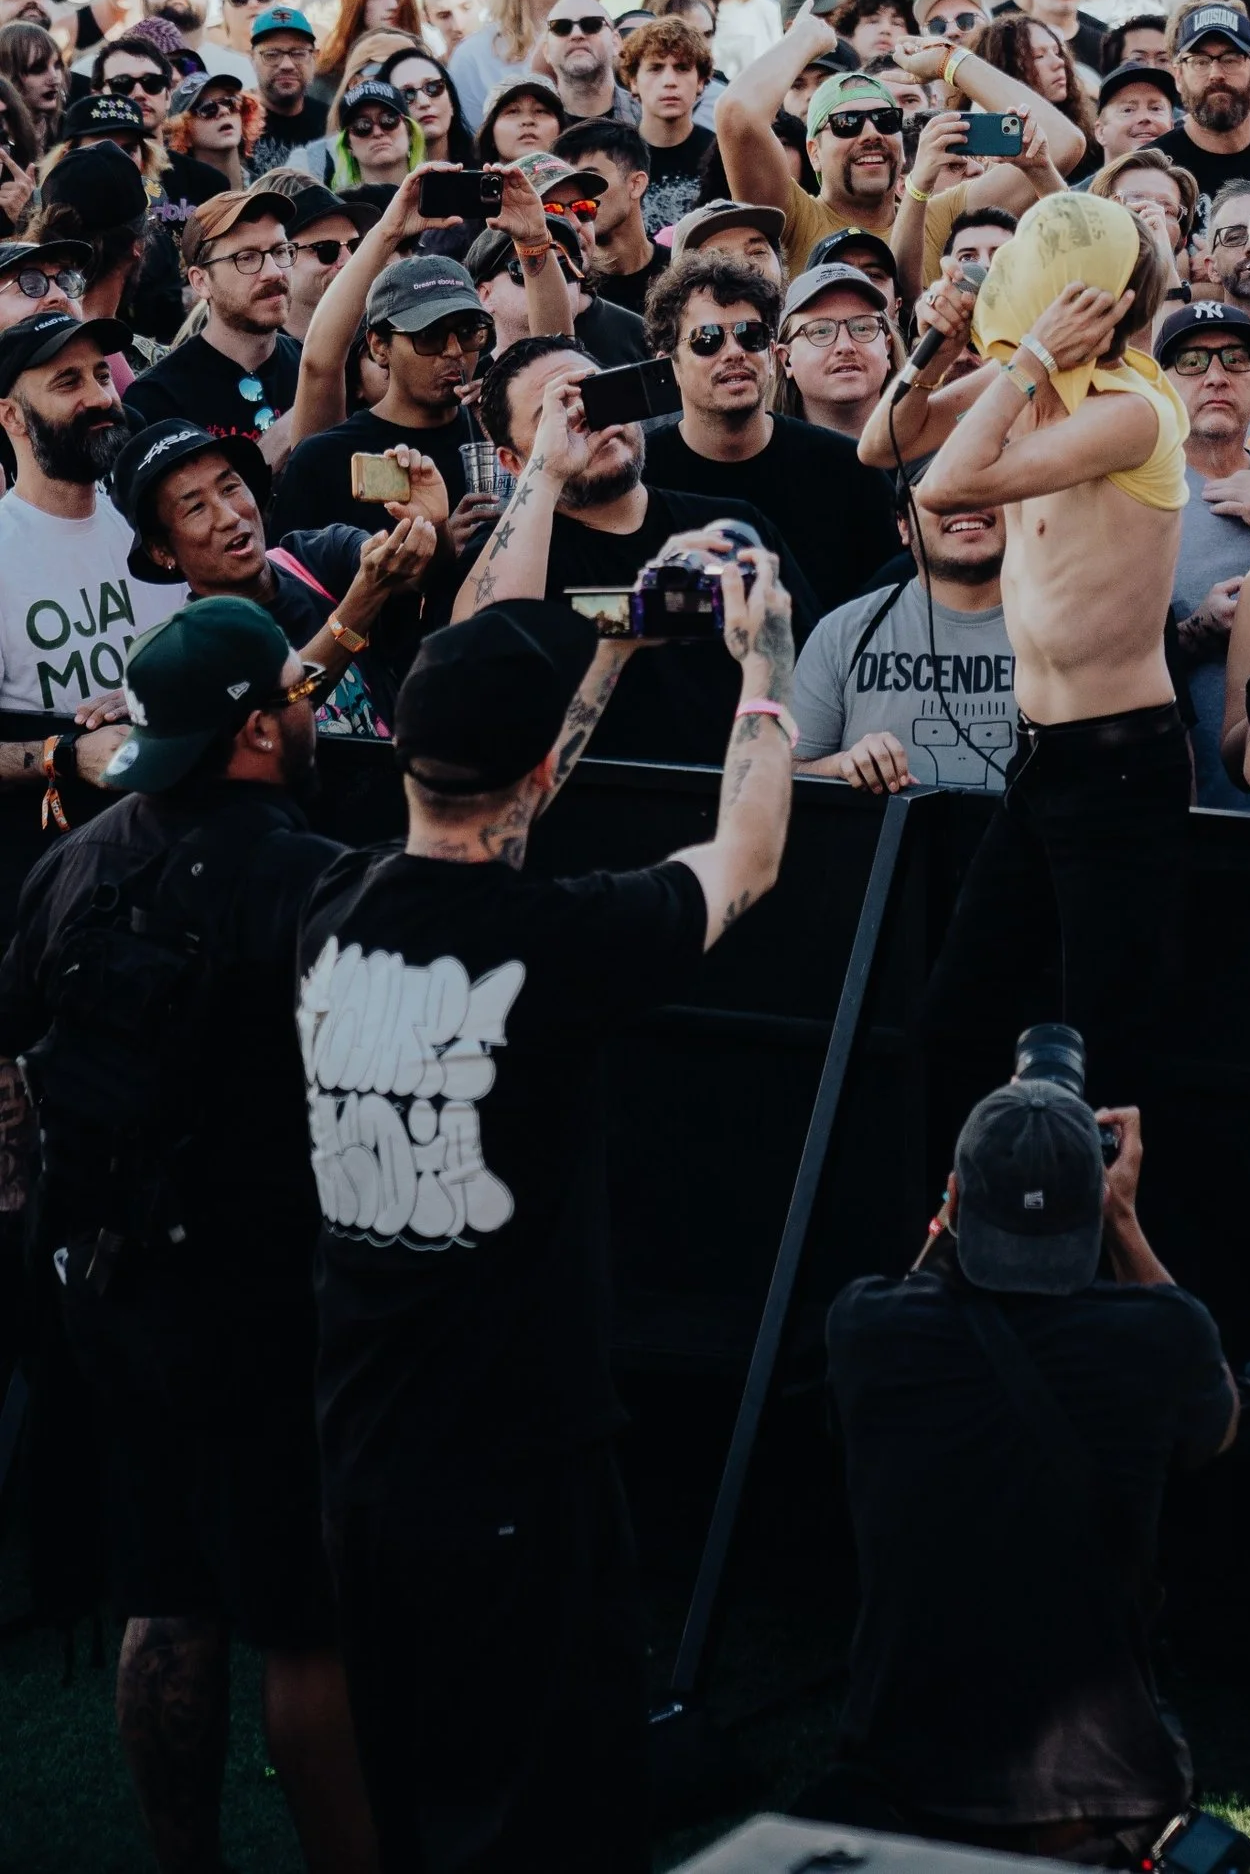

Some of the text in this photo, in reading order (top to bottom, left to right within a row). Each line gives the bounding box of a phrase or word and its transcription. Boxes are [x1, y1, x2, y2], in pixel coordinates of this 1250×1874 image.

[1193, 7, 1239, 32] LOUISIANA
[26, 579, 136, 651] OJAI
[857, 651, 1017, 694] DESCENDE
